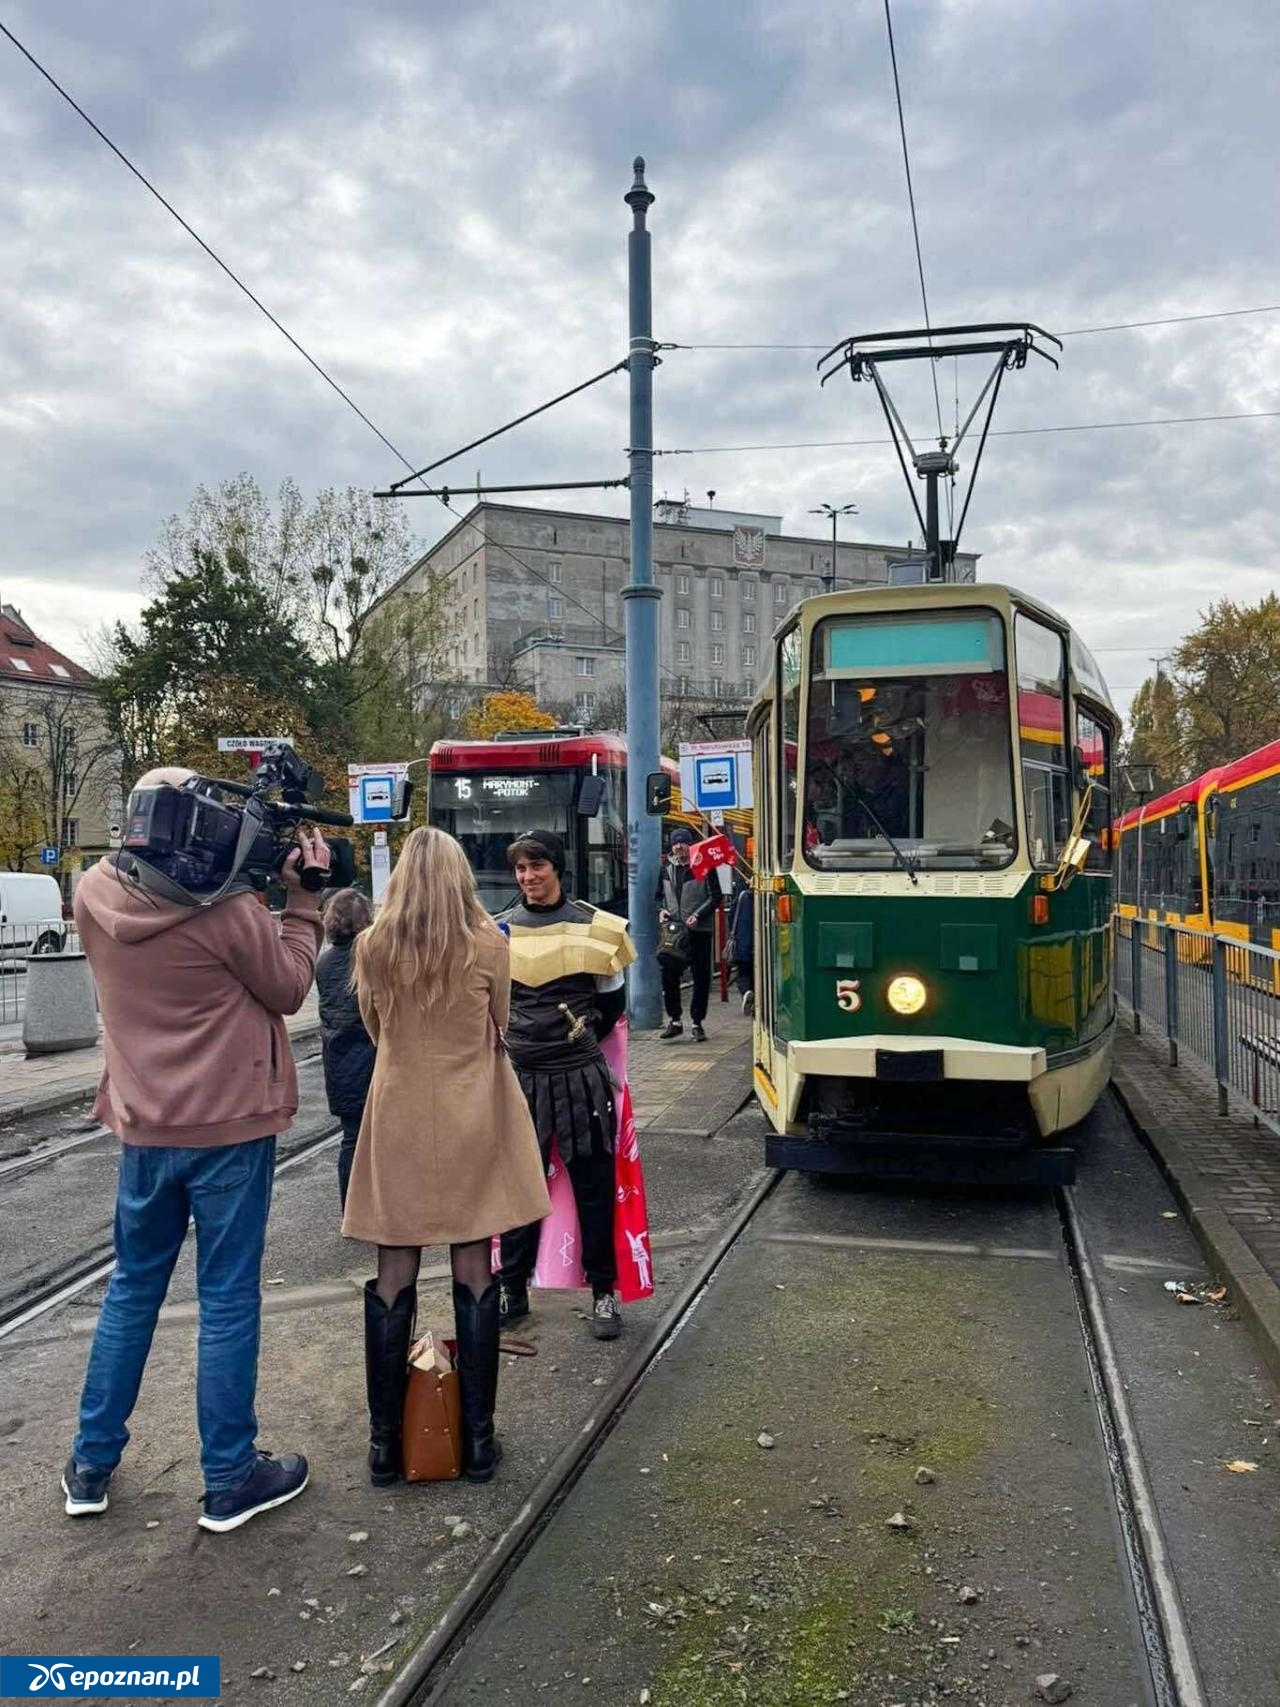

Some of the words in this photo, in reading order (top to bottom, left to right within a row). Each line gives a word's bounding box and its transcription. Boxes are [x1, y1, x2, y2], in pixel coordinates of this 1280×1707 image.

[455, 778, 472, 799] 15
[483, 779, 540, 789] MARYMONT-
[46, 849, 56, 863] P
[836, 979, 862, 1013] 5
